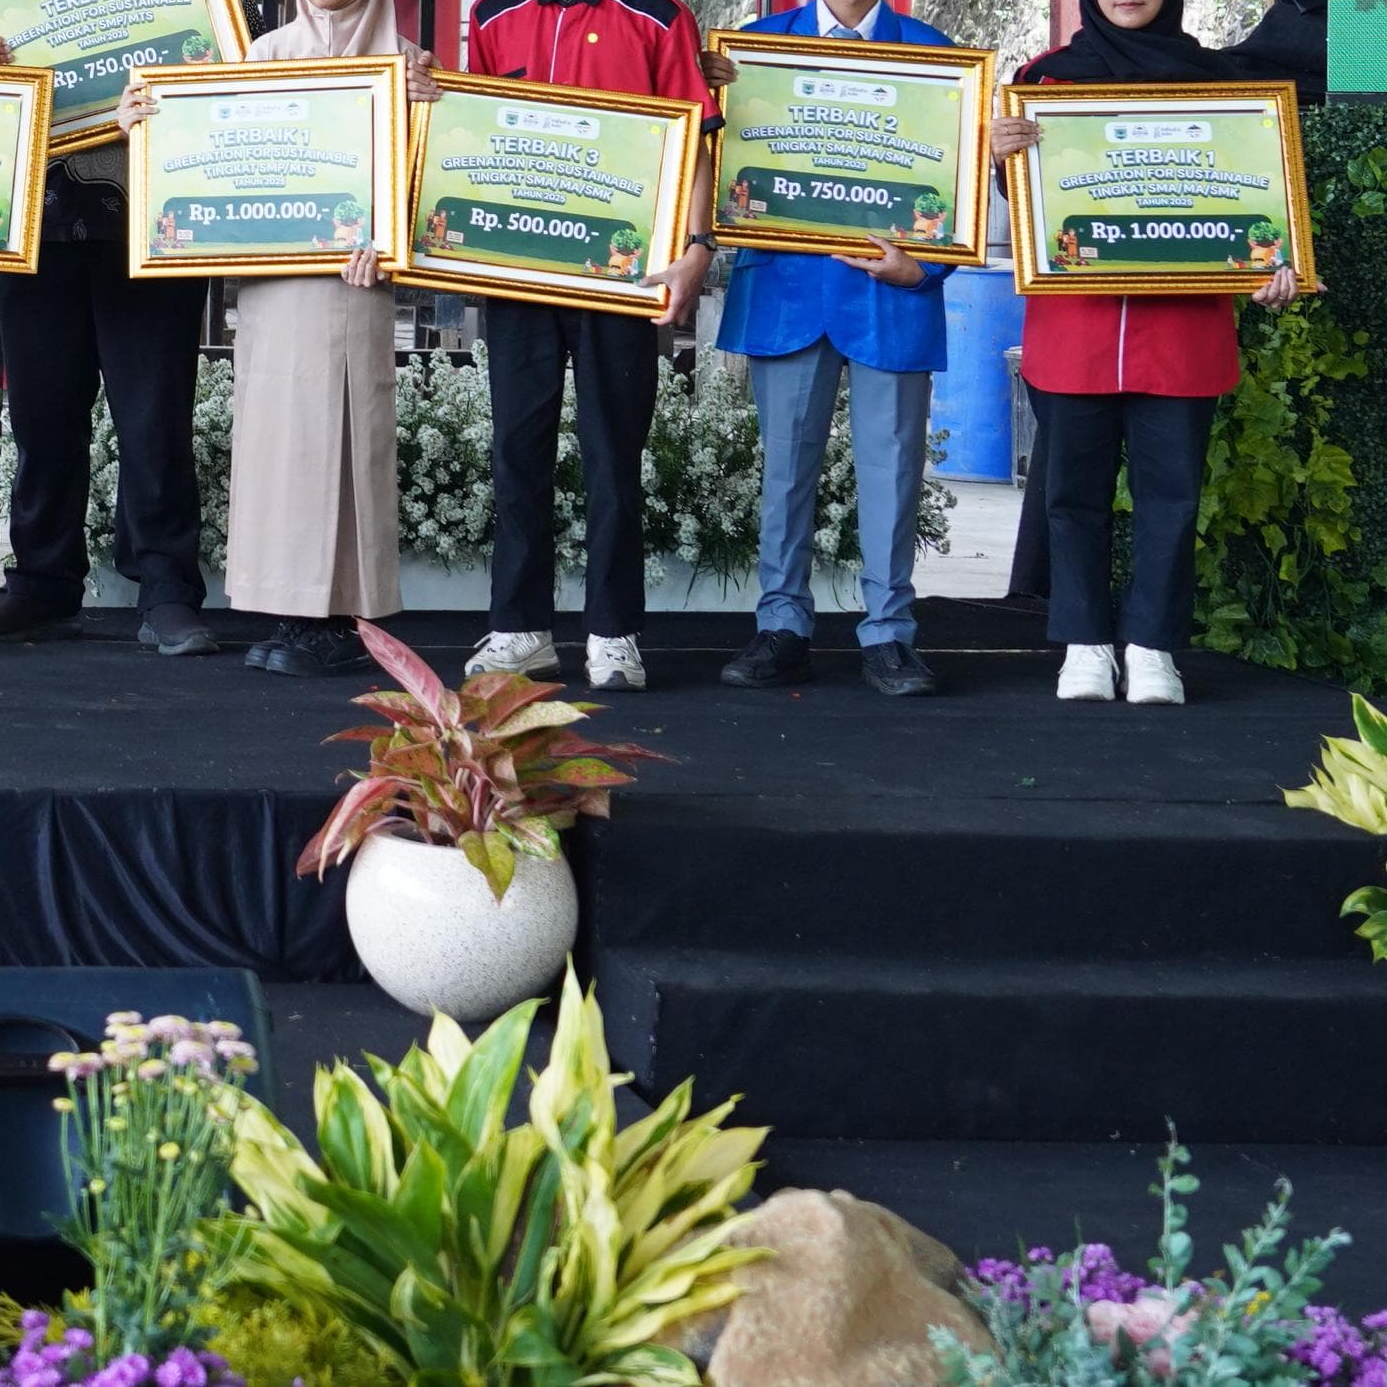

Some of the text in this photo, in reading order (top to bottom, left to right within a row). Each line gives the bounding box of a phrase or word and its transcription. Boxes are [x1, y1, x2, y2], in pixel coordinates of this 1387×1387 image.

[6, 13, 81, 49] GREENATION
[82, 6, 108, 21] FOR
[47, 11, 154, 47] TINGKAT SMP/MTS
[78, 36, 108, 50] TAHUN
[54, 47, 170, 89] Rp. 750.000,-
[788, 106, 898, 132] TERBAIK 2
[210, 127, 310, 149] TERBAIK 1
[741, 126, 944, 161] GREENATION FOR SUSTAINABLE
[163, 148, 358, 172] GREENATION FOR SUSTAINABLE
[491, 136, 600, 165] TERBAIK 3
[768, 140, 914, 168] TINGKAT SMA/MA/SMK
[812, 157, 844, 167] TAHUN
[1107, 149, 1215, 168] TERBAIK 1
[204, 163, 316, 180] TINGKAT SMP/MTS
[442, 156, 644, 195] GREENATION FOR SUSTAINABLE
[1059, 168, 1269, 190] GREENATION FOR SUSTAINABLE
[469, 170, 613, 203] TINGKAT SMA/MA/SMK
[512, 188, 543, 201] TAHUN
[773, 177, 902, 209] Rp. 750.000,-
[1089, 184, 1239, 200] TINGKAT SMA/MA/SMK
[189, 202, 330, 225] Rp. 1.000.000,-
[1136, 198, 1169, 208] TAHUN
[470, 208, 600, 244] Rp. 500.000,-
[1091, 221, 1244, 243] Rp. 1.000.000,-
